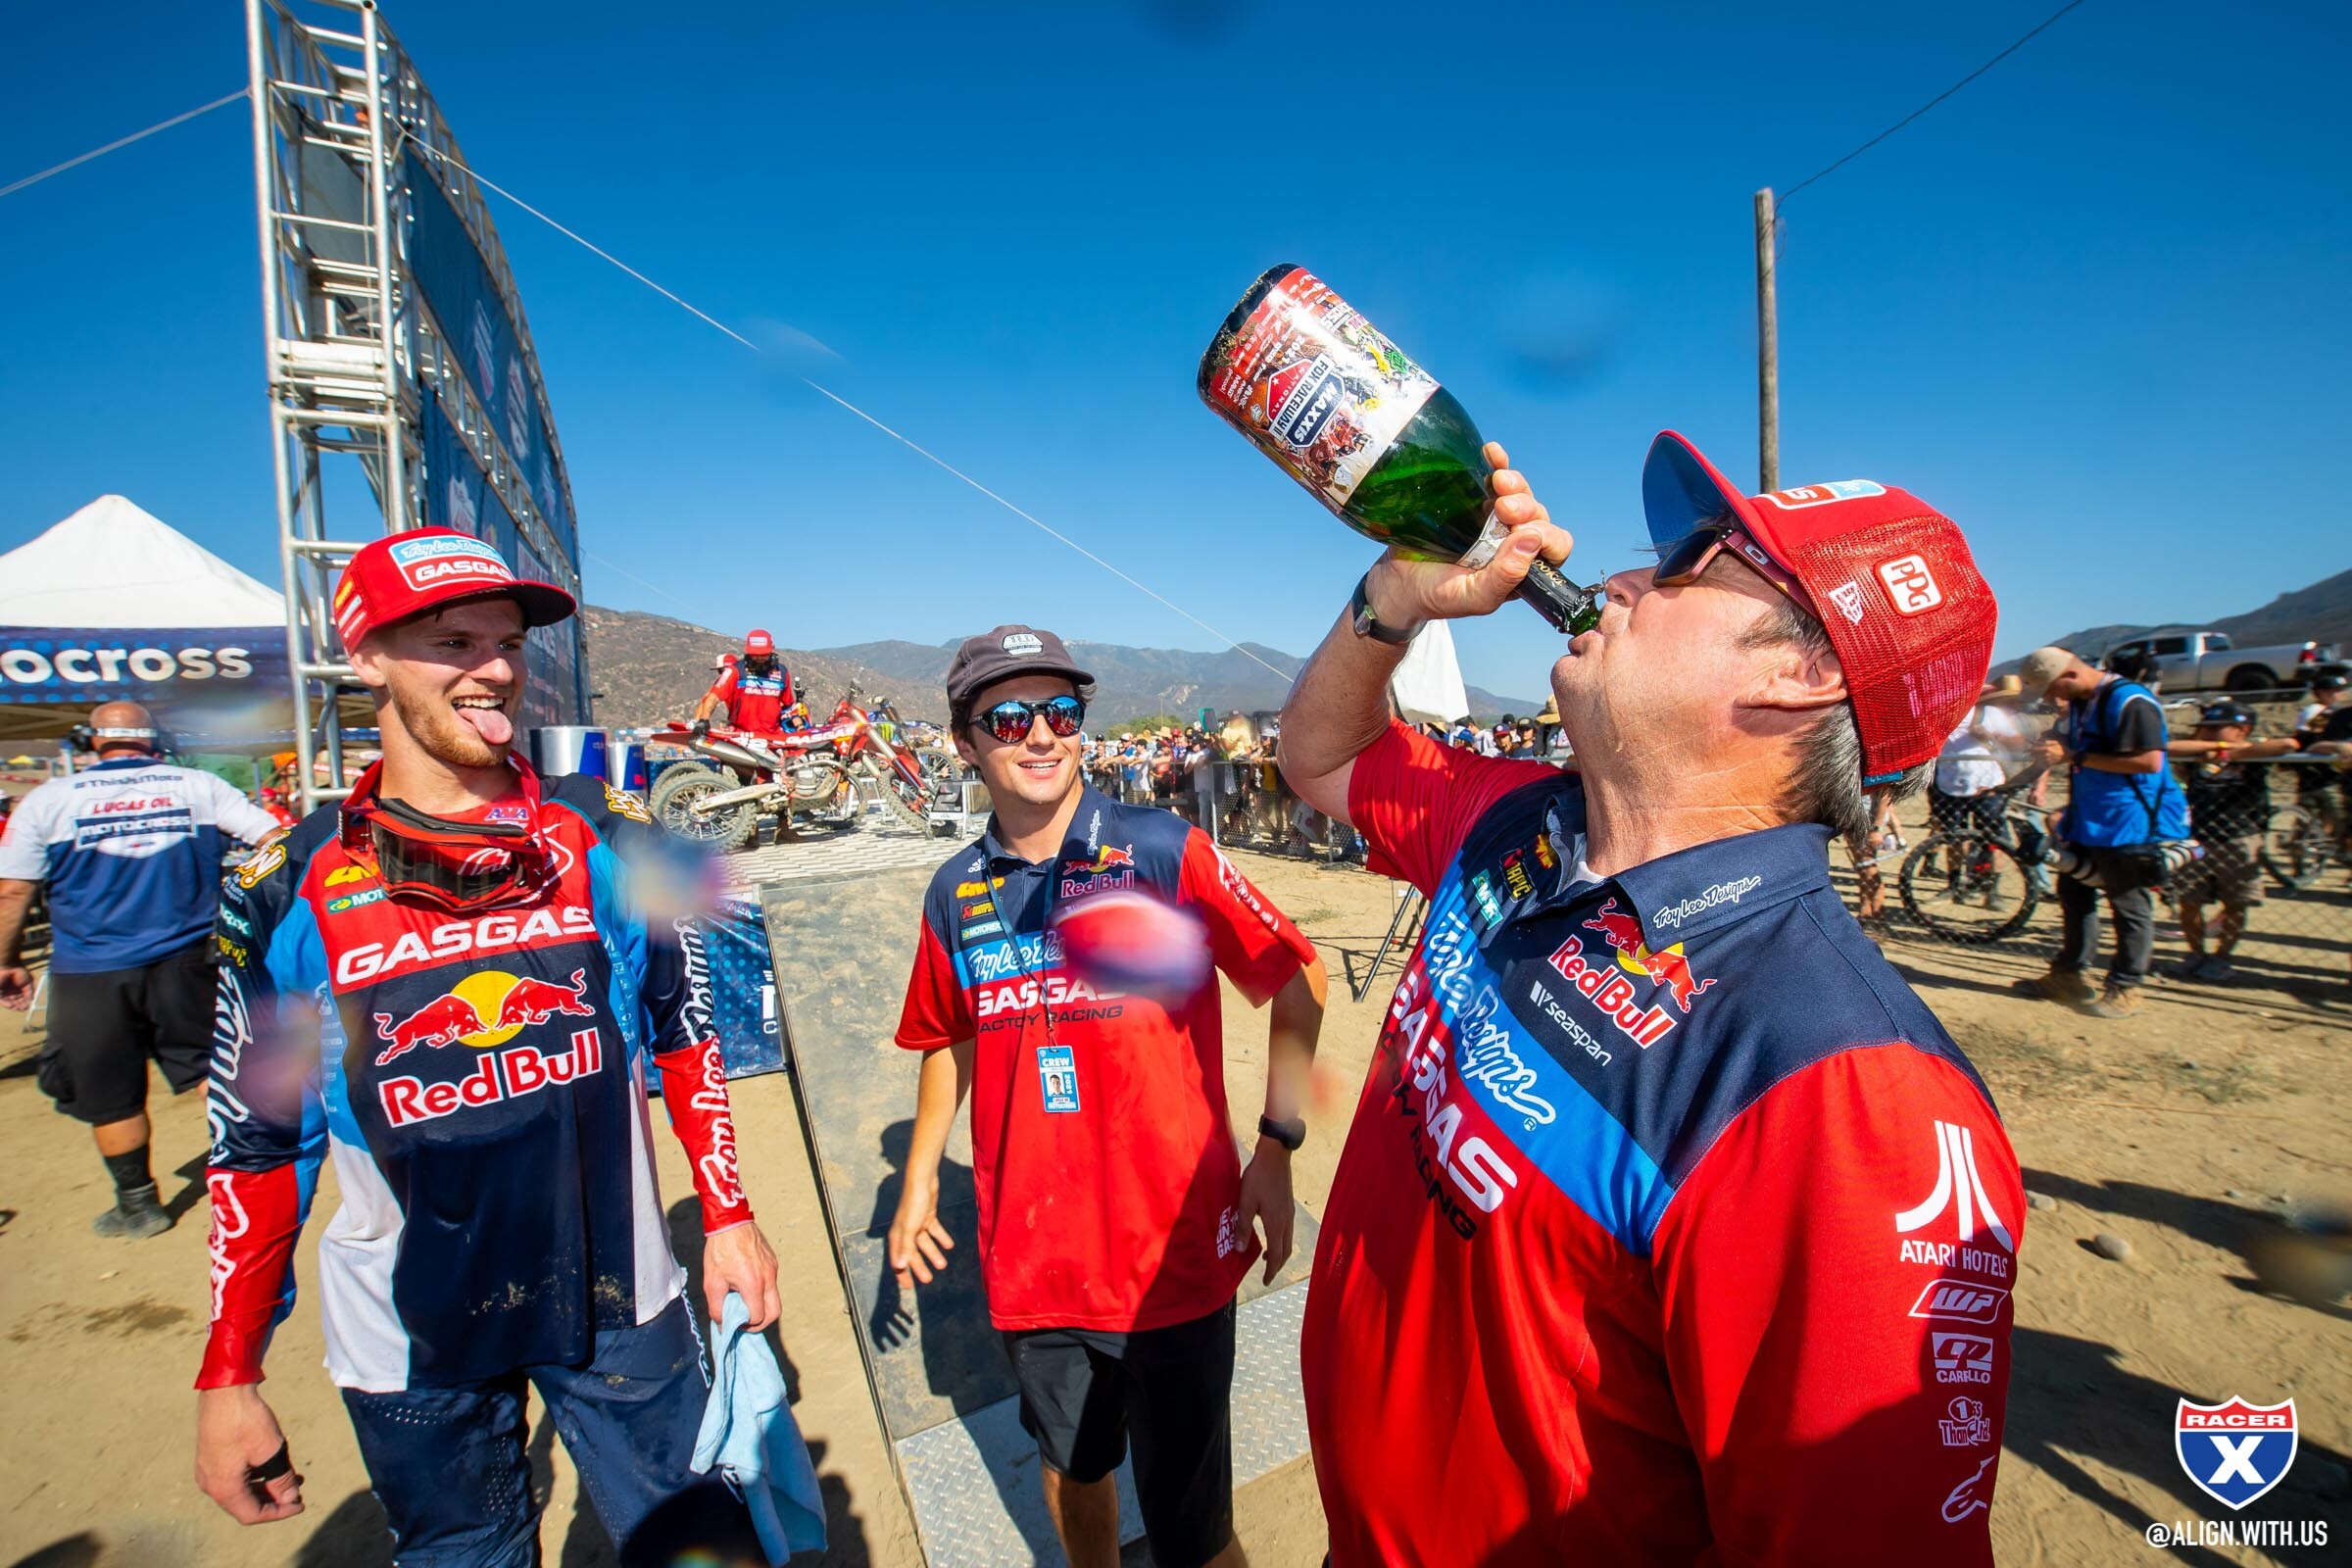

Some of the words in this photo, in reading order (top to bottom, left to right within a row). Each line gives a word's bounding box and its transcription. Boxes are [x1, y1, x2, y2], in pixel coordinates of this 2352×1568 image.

[1282, 335, 1305, 364] 2021
[1310, 360, 1329, 383] FOX
[1238, 394, 1251, 410] NBC
[1272, 368, 1305, 413] NATIONAL
[1278, 379, 1314, 430] RACEWAY
[1295, 381, 1339, 443] MAXXIS
[415, 560, 512, 582] GASGAS
[0, 647, 254, 684] ocross
[92, 799, 146, 814] LUCAS
[150, 797, 173, 809] OIL
[351, 888, 385, 907] MOT
[1060, 873, 1098, 899] Red
[1098, 869, 1135, 892] Bull
[1653, 904, 1683, 928] Troy
[1681, 898, 1705, 919] Lee
[1703, 876, 1762, 907] Designs
[336, 906, 597, 985] GASGAS
[1547, 934, 1619, 1004] Red
[1592, 974, 1679, 1051] Bull
[1047, 1004, 1124, 1025] RACING
[1544, 1000, 1613, 1067] seaspan
[1042, 1057, 1069, 1067] CREW
[1459, 983, 1556, 1126] Designs
[377, 1052, 504, 1128] Red
[501, 1027, 603, 1099] Bull
[1064, 1074, 1073, 1094] 2021
[1899, 1239, 1956, 1268] ATARI
[1962, 1247, 2008, 1279] HOTELS
